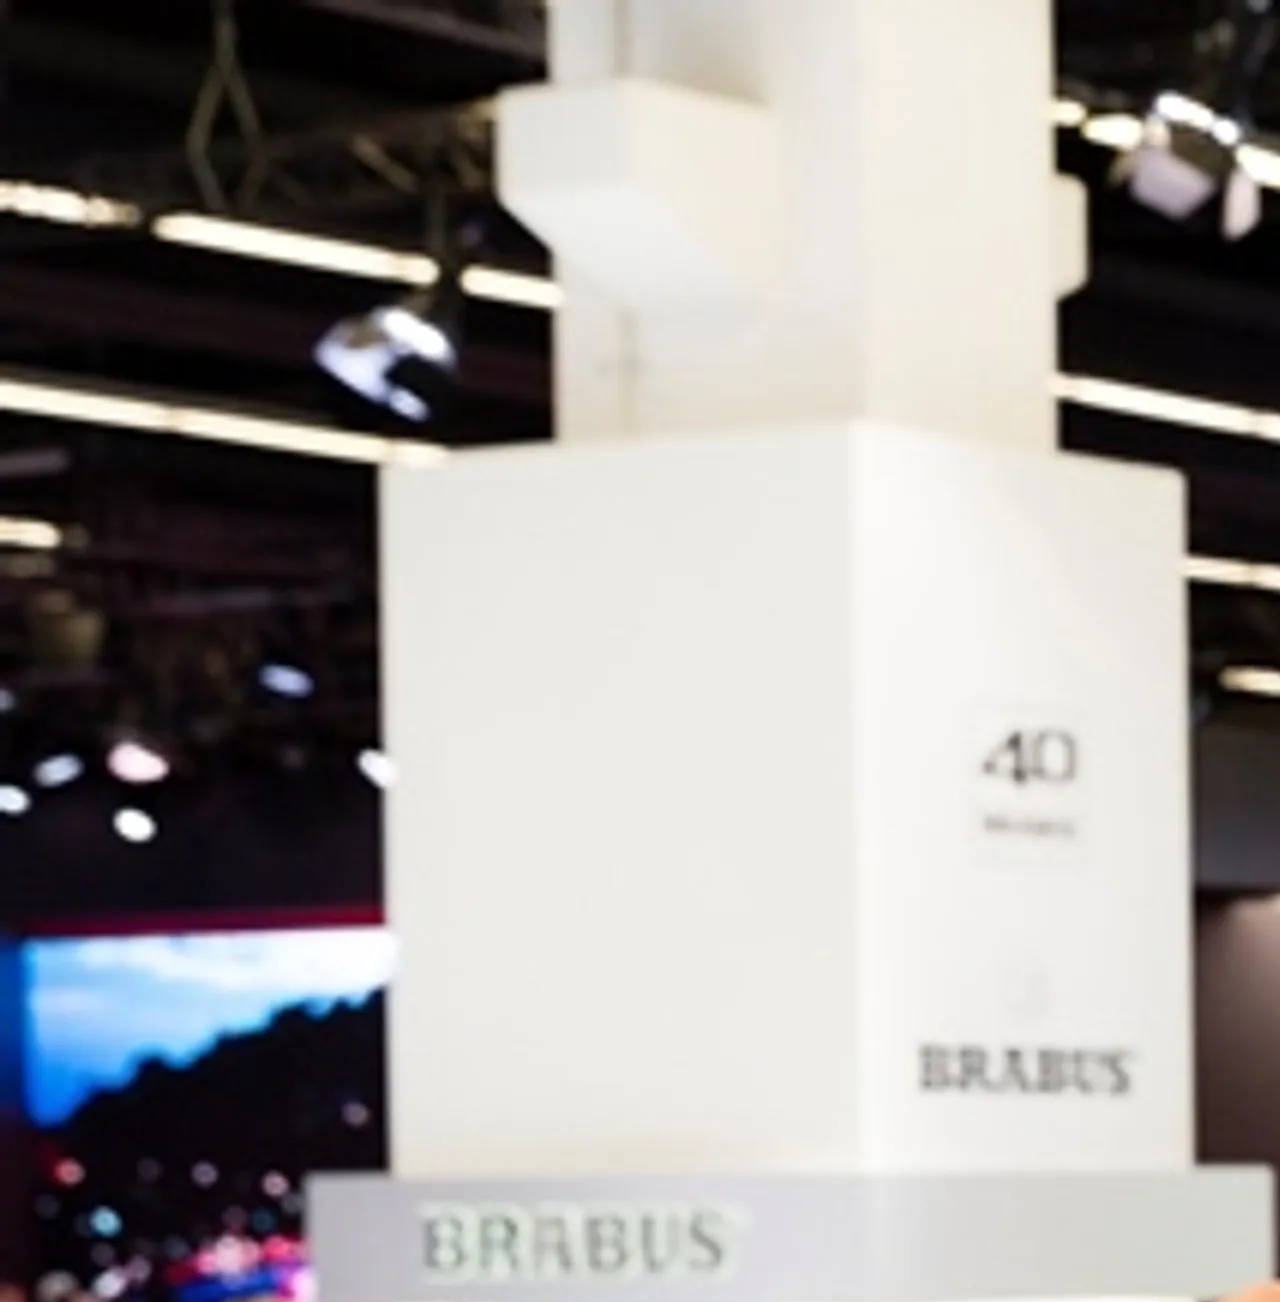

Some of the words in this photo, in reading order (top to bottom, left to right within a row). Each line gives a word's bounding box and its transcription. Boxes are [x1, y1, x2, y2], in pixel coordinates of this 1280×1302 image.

[981, 729, 1079, 785] 40
[916, 1043, 1134, 1097] BRABUS
[421, 1208, 726, 1275] BRABUS
